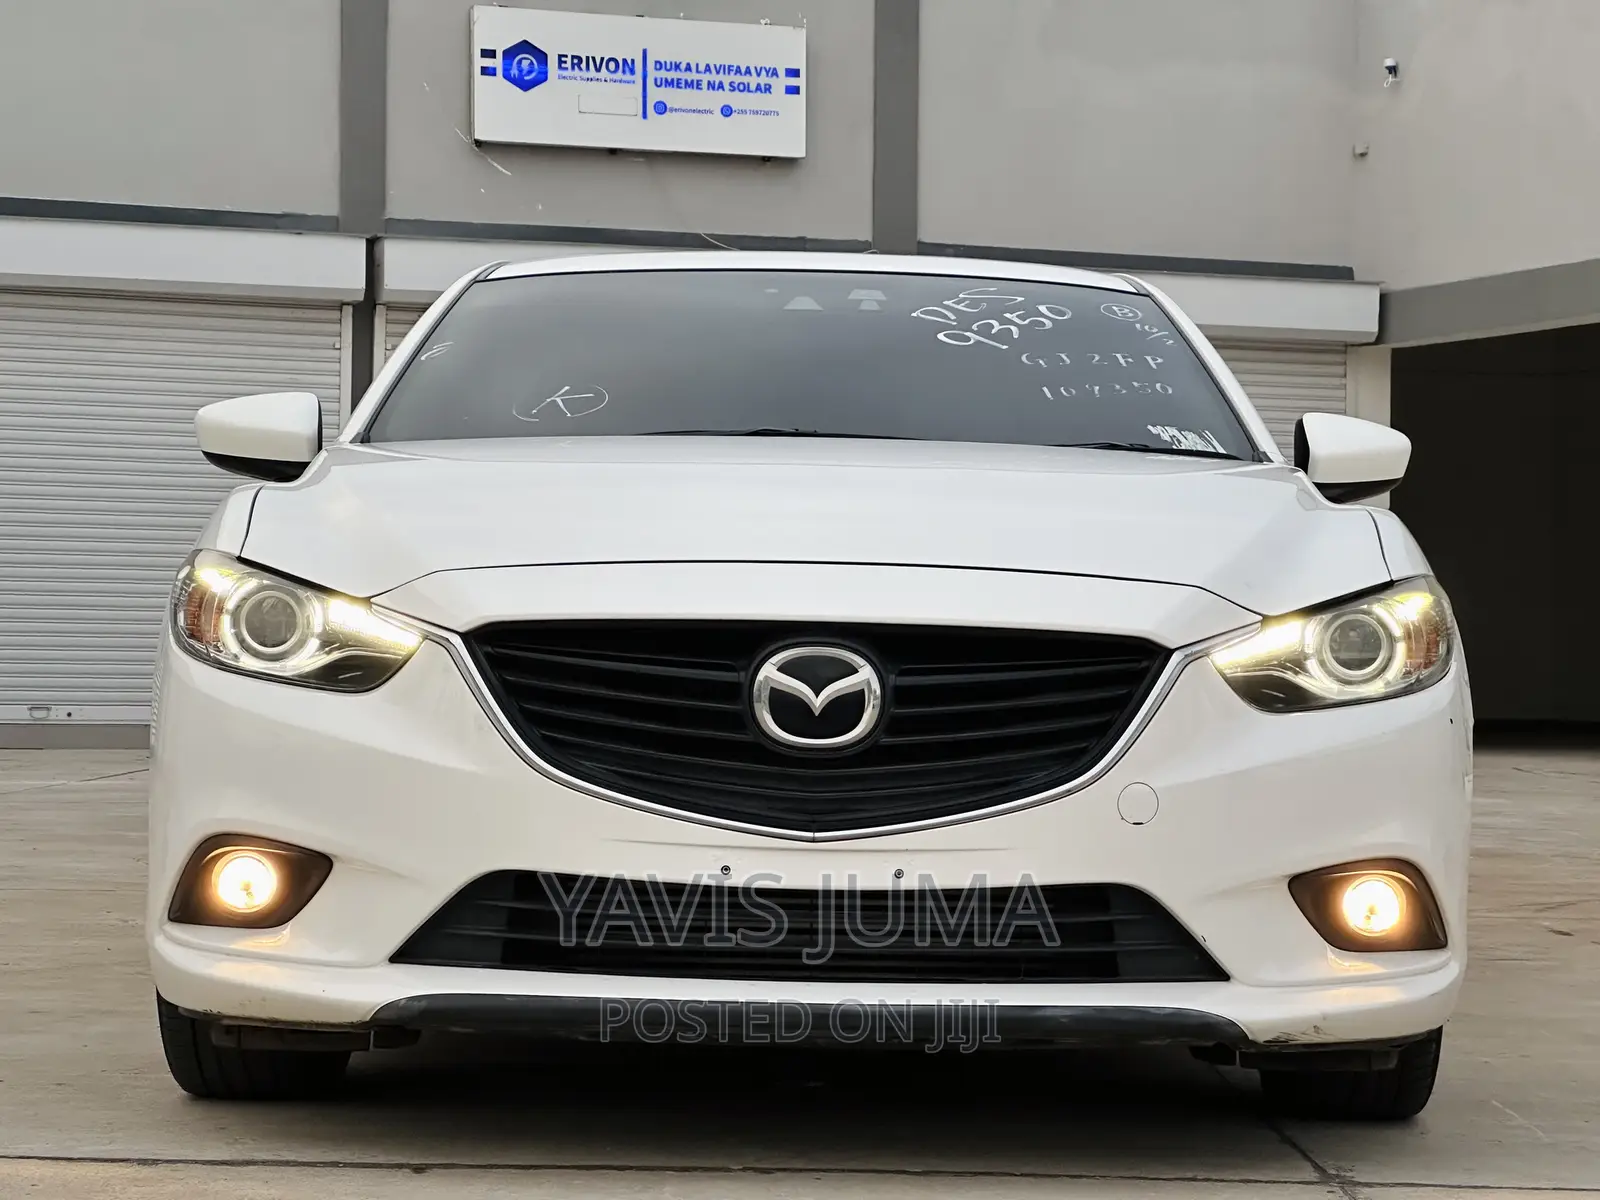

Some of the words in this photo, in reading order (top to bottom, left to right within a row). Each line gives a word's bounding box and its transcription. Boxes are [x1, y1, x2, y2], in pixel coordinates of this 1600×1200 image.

[557, 53, 636, 76] ERIVON
[654, 60, 692, 74] DUKA
[755, 66, 779, 78] VYA
[558, 73, 578, 81] Electric
[580, 75, 602, 84] Supplies
[654, 77, 703, 90] UMEME
[707, 80, 725, 92] NA
[728, 81, 772, 94] SOLAR
[668, 106, 714, 115] @erivonelectric
[937, 304, 1072, 349] 9350
